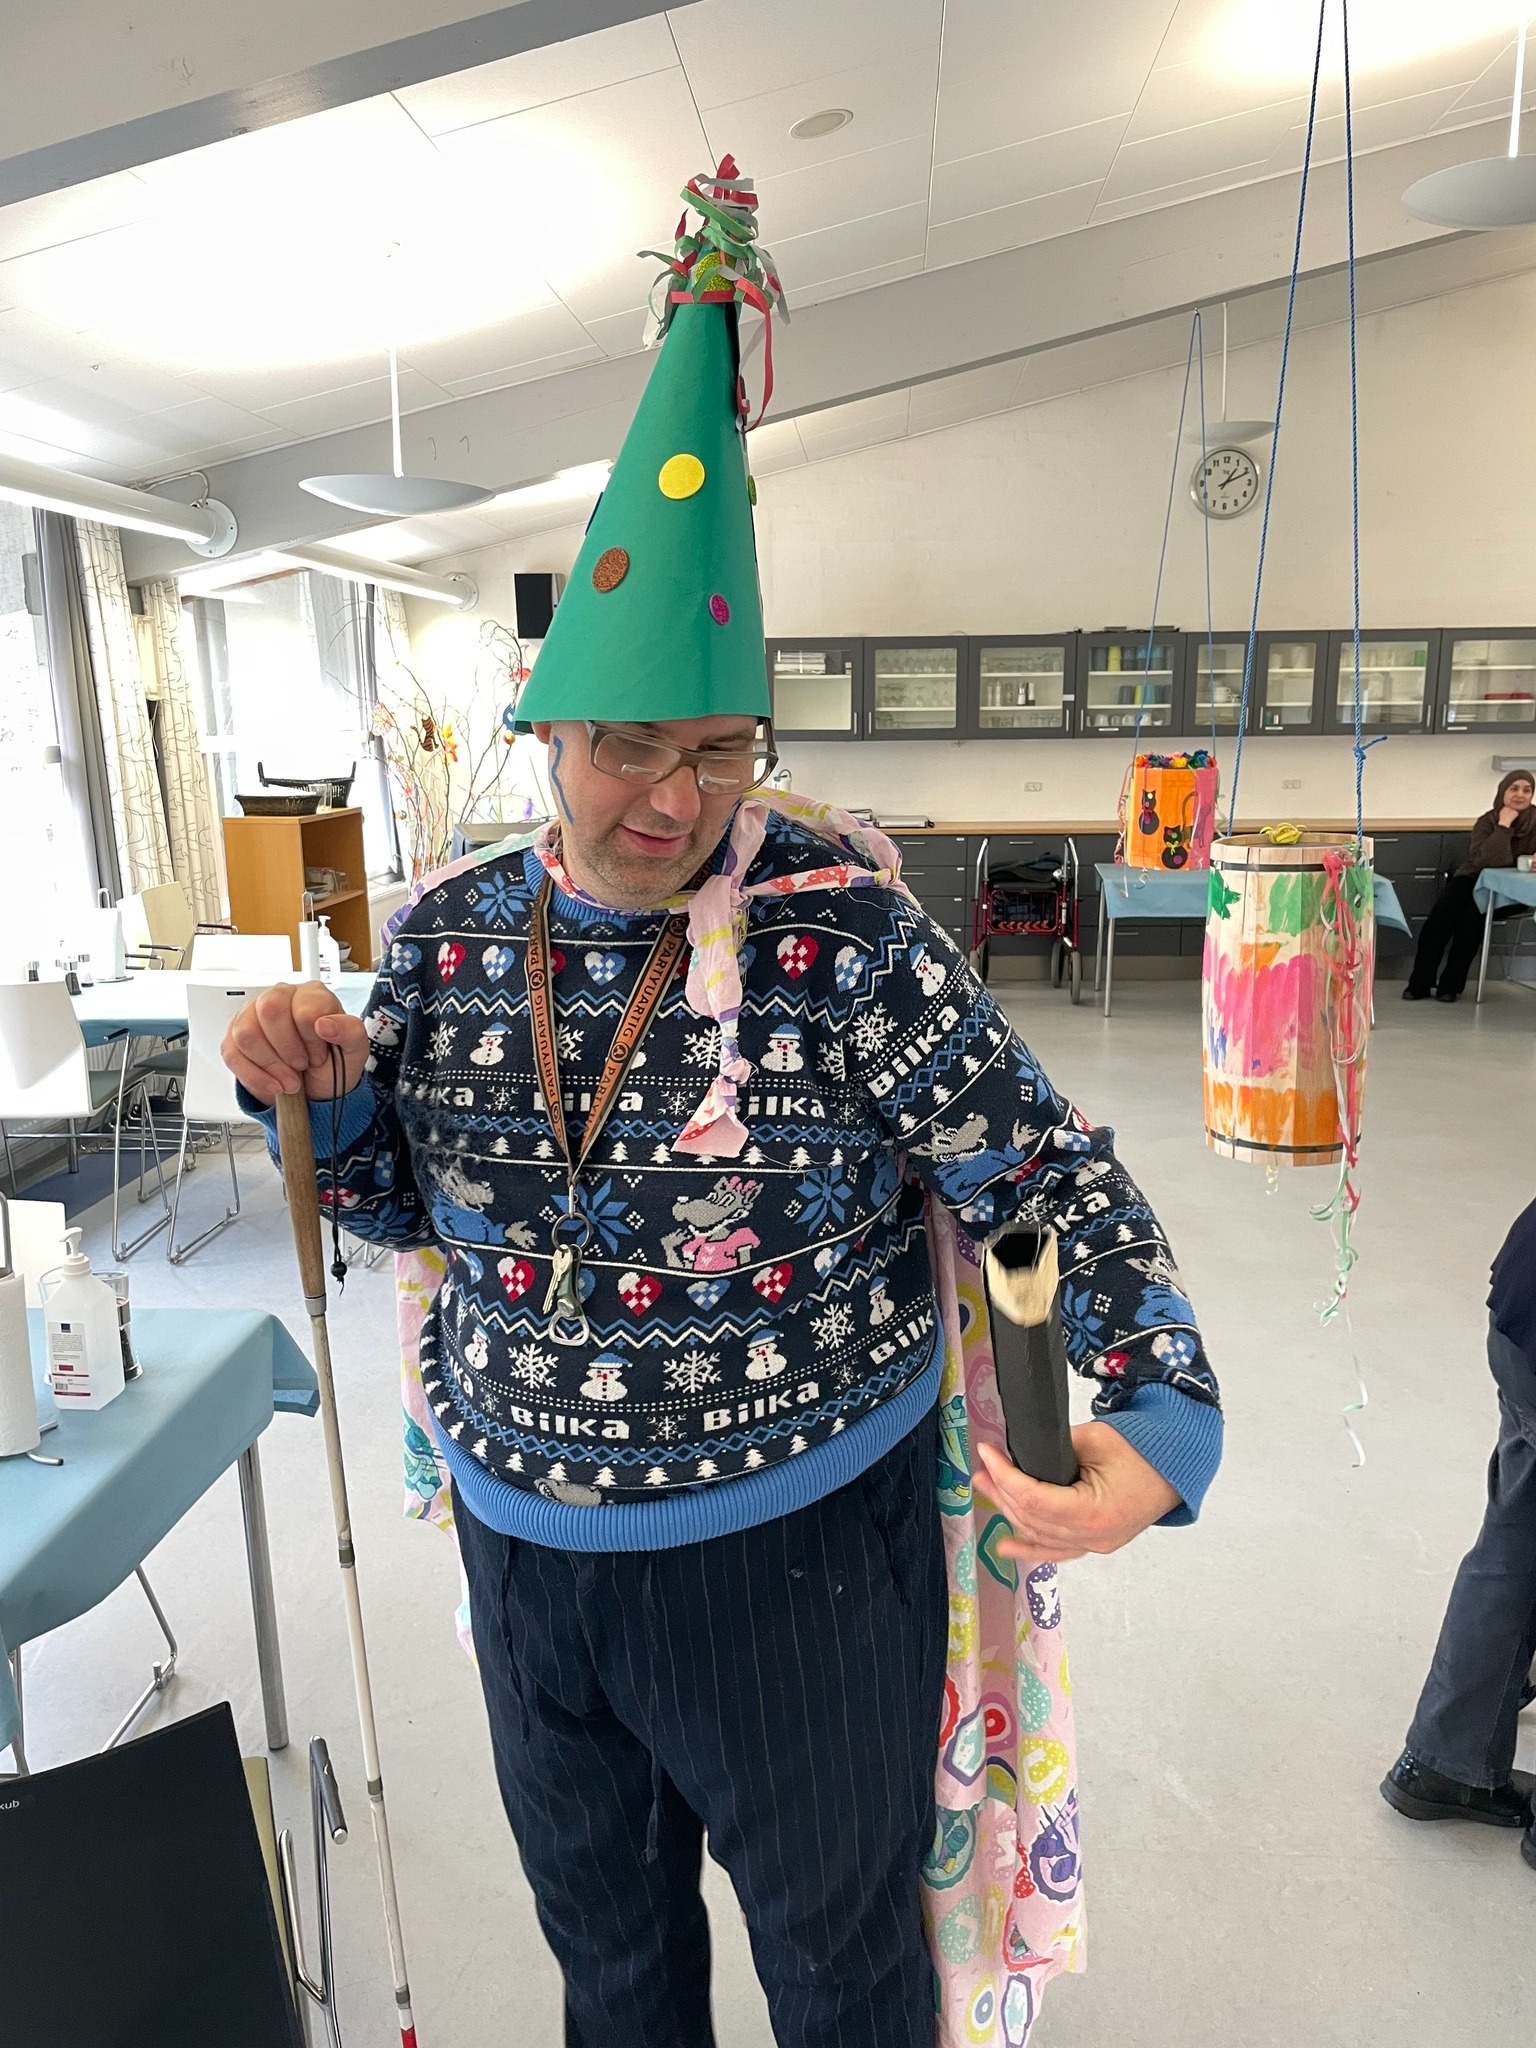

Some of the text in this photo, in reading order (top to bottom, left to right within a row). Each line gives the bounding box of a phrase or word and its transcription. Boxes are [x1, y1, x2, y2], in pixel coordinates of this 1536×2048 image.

[1223, 456, 1231, 464] 12
[1247, 479, 1252, 487] 3
[1242, 490, 1247, 498] 4
[1212, 500, 1217, 508] 7
[1222, 502, 1227, 510] 6
[1233, 499, 1239, 507] 5
[533, 1091, 644, 1112] ila
[735, 1095, 826, 1119] ilka
[702, 1381, 821, 1432] Bilka
[510, 1404, 631, 1440] Bilka
